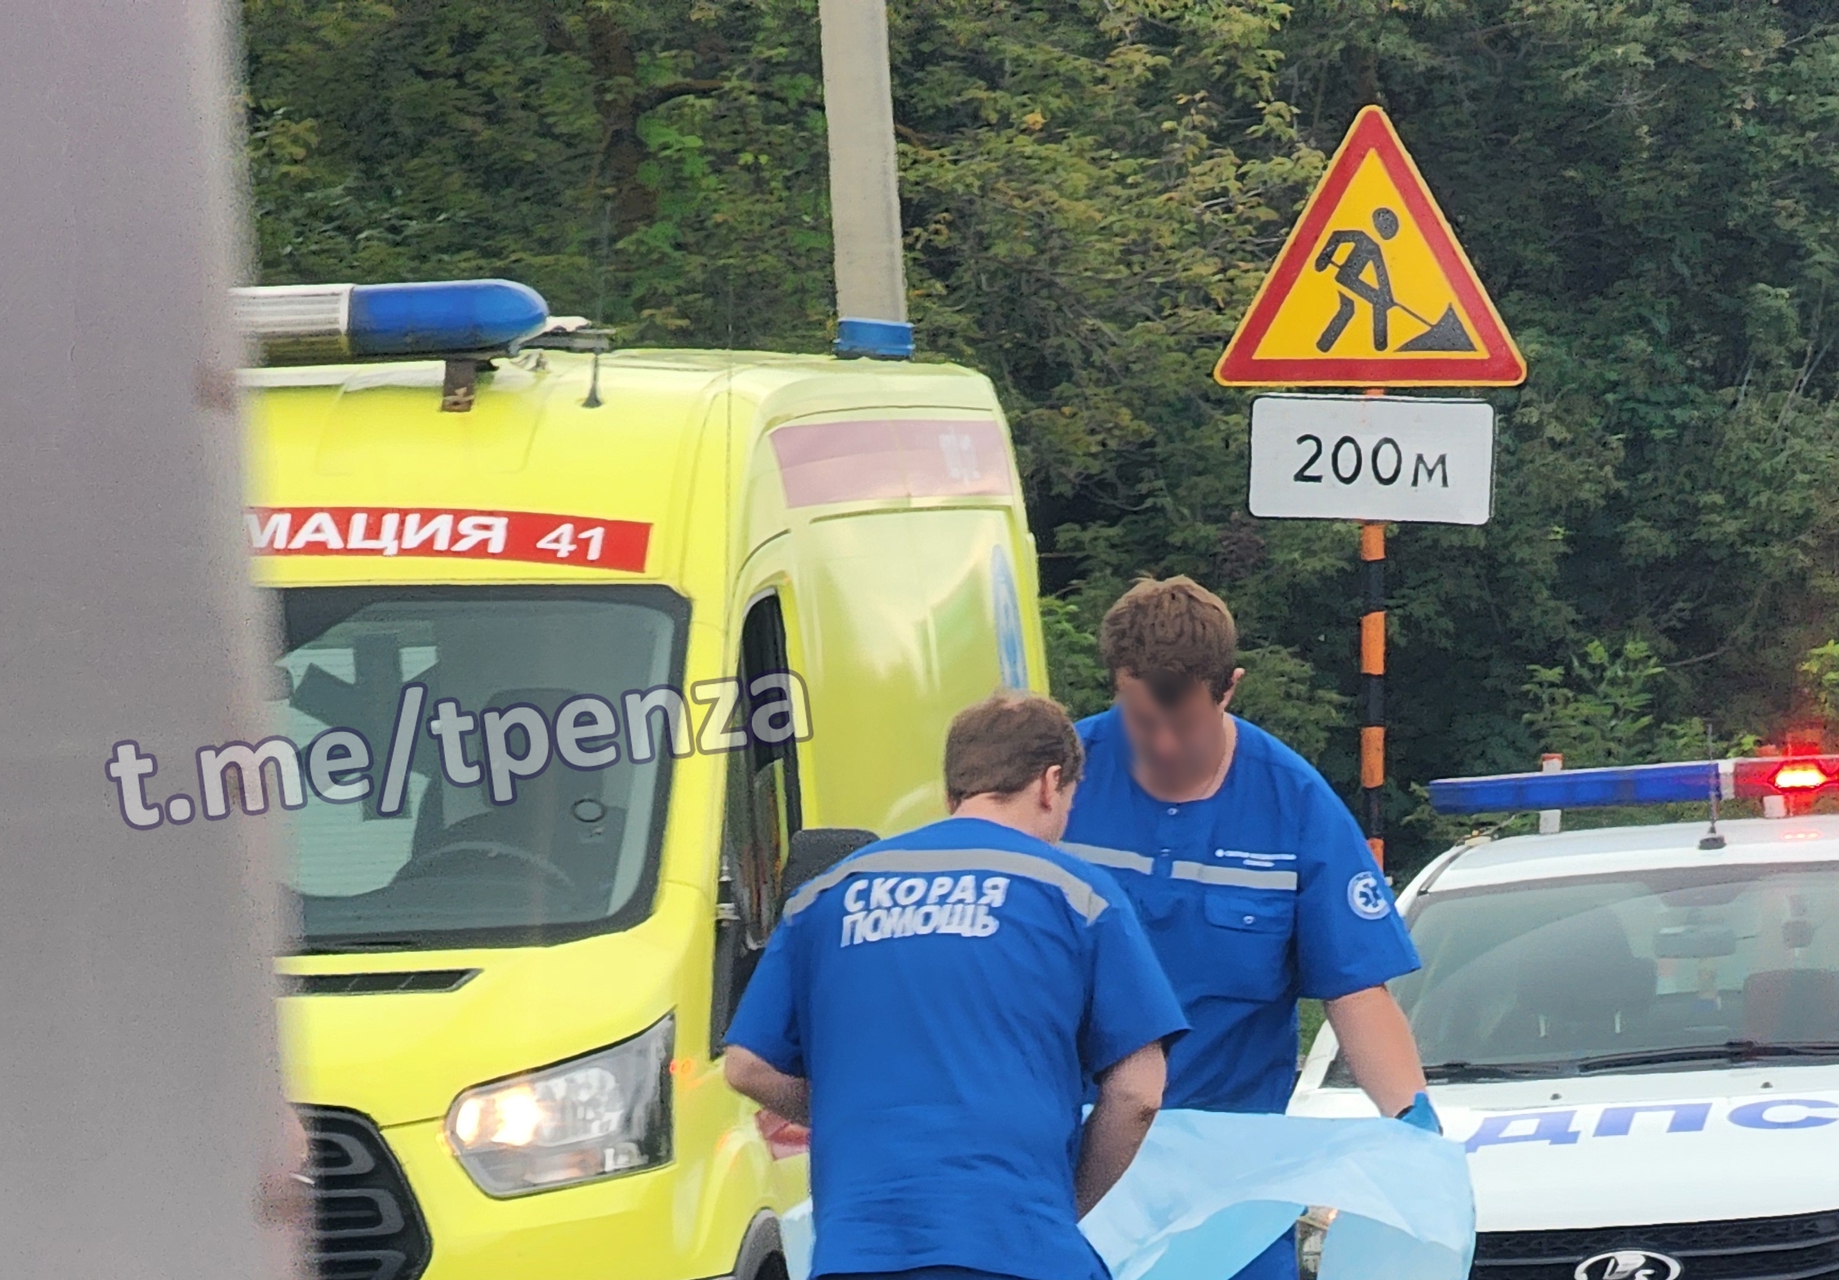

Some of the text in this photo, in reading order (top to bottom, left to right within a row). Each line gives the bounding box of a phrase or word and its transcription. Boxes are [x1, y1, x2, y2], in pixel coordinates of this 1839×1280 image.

[535, 525, 607, 562] 41
[843, 874, 1011, 913] СКОРАЯ
[840, 903, 999, 948] ПОМОЩЬ
[1465, 1099, 1839, 1154] ДПС
